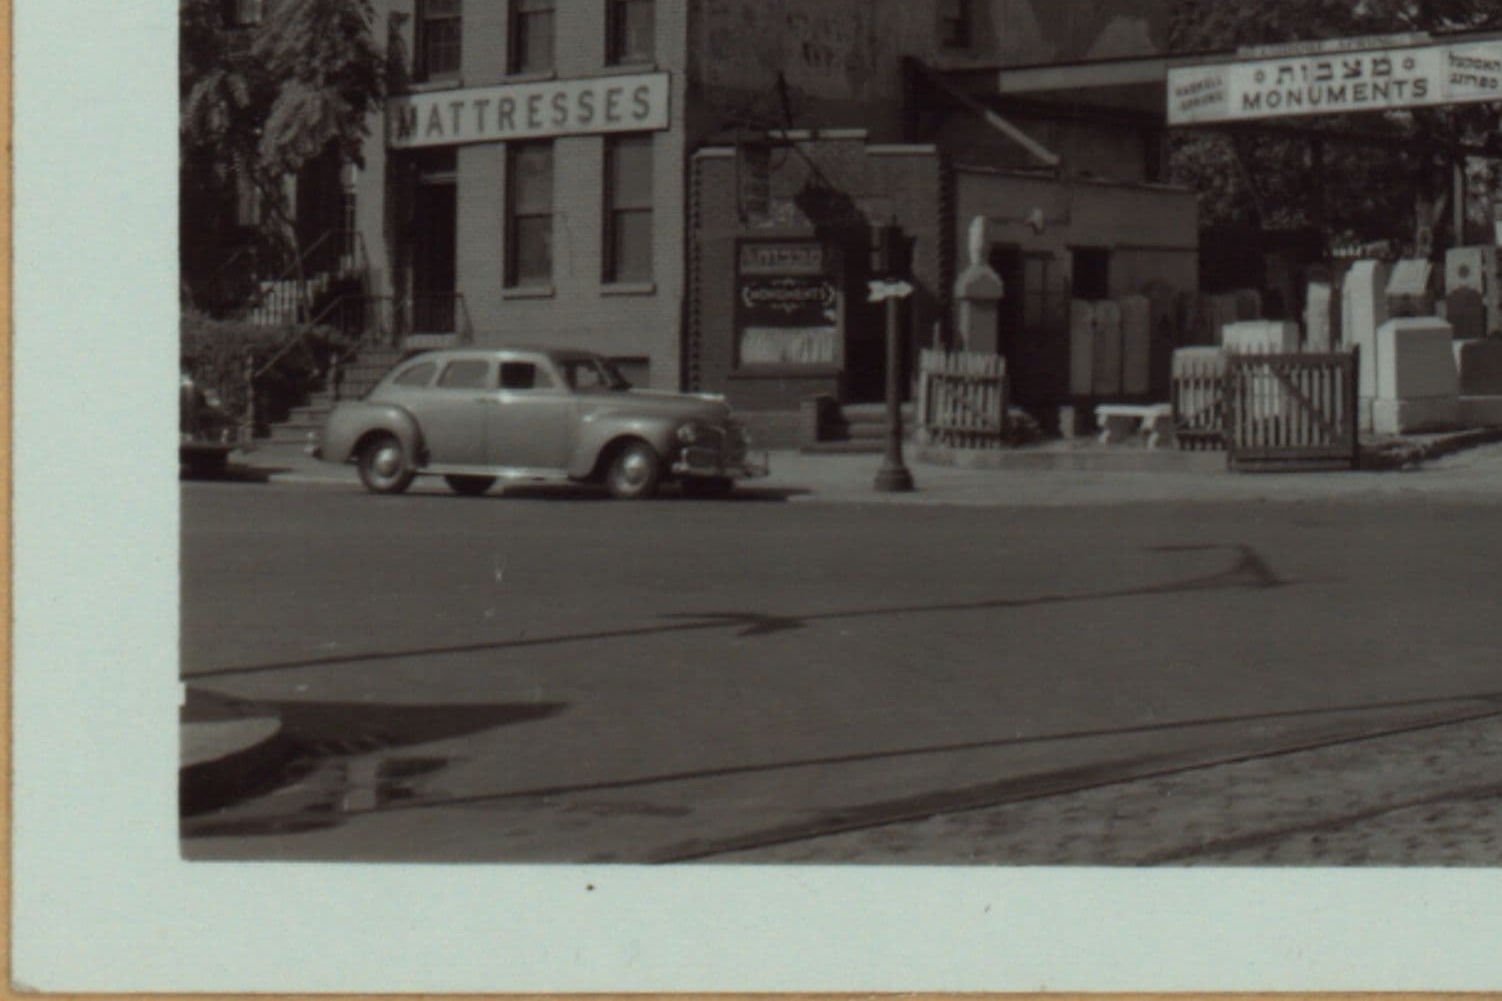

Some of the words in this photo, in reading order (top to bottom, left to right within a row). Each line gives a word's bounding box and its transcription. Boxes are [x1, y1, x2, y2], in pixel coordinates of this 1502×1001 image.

[1278, 57, 1392, 85] מצבות
[1242, 77, 1428, 111] MONUMENTS
[397, 85, 650, 140] MATTRESSES
